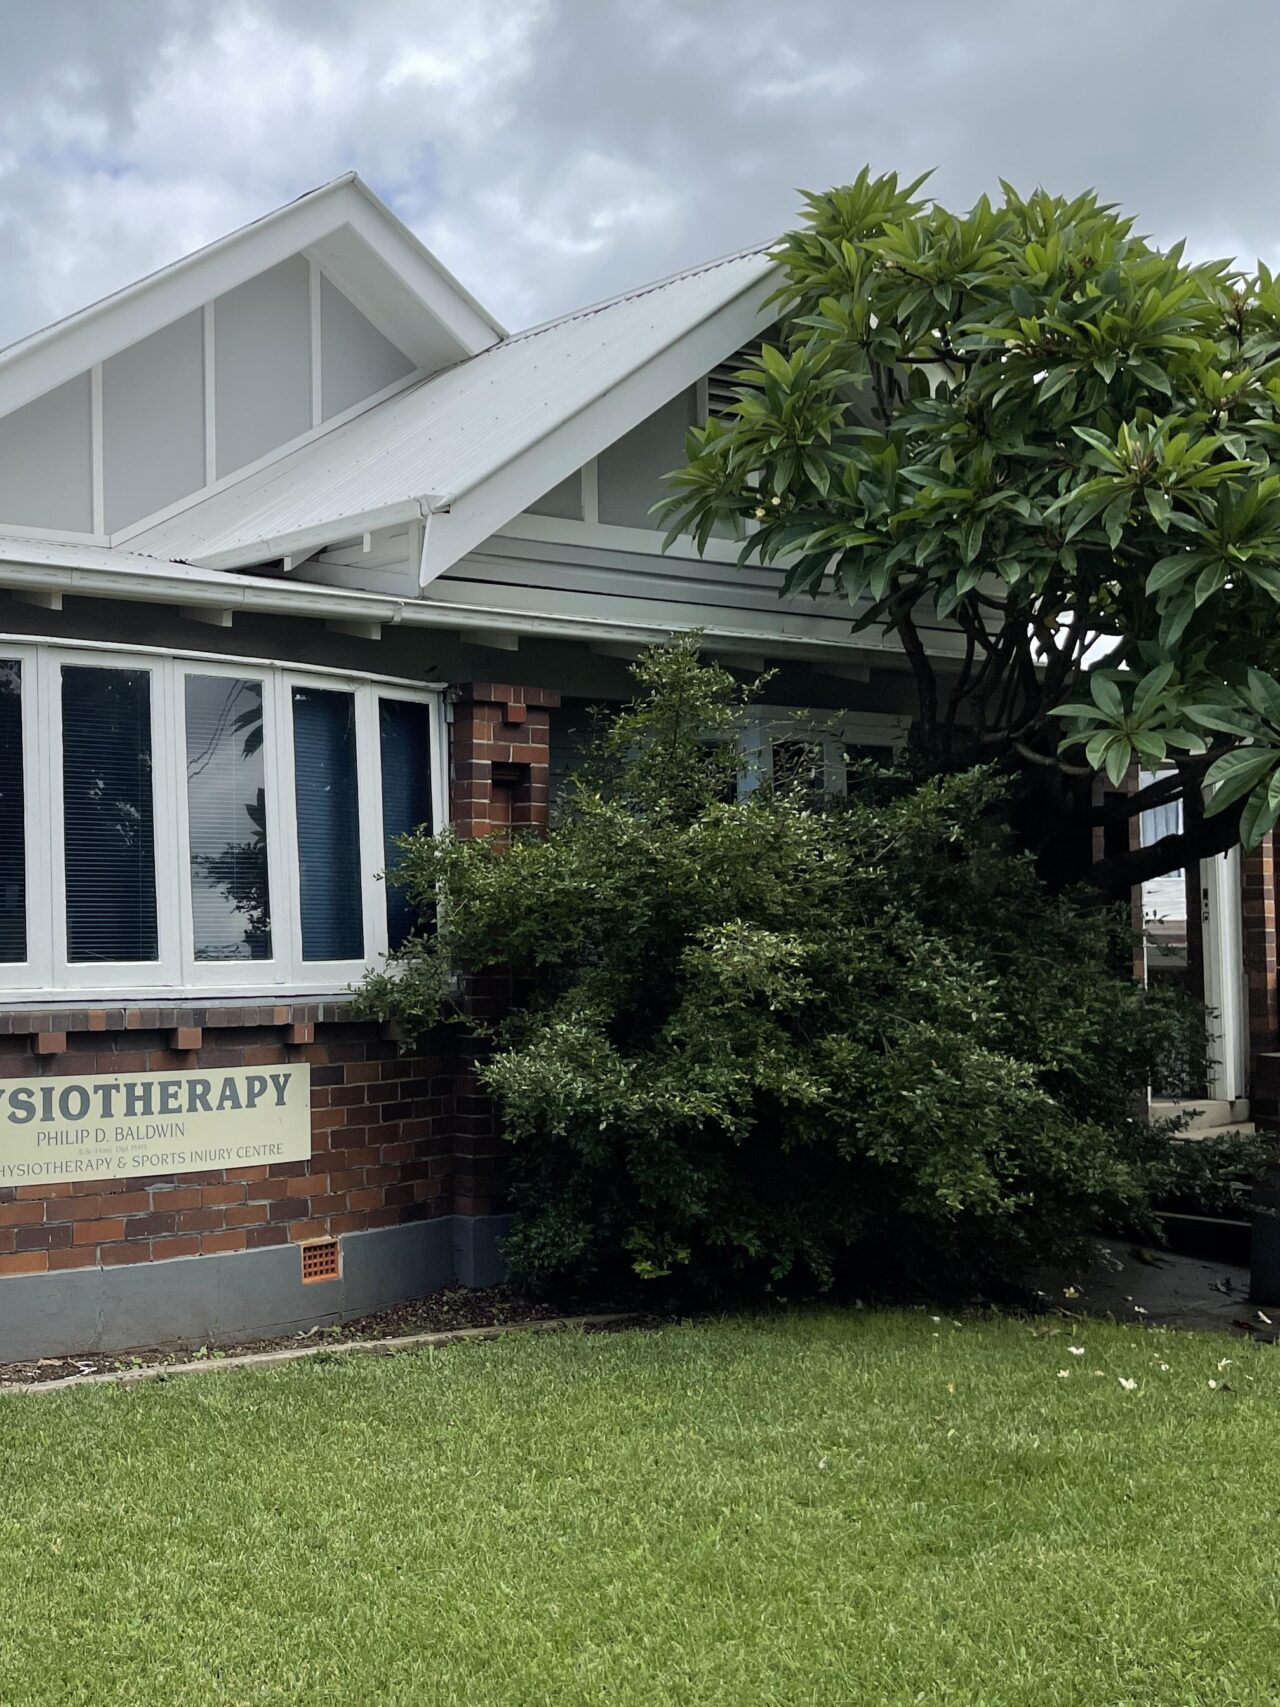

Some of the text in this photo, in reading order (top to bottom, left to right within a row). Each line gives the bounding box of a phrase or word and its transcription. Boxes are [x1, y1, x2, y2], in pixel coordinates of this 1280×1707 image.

[36, 1121, 186, 1147] PHILIP D. BALDWIN
[117, 1156, 128, 1169] &
[132, 1151, 186, 1168] SPORTS
[190, 1146, 234, 1164] INJURY
[236, 1143, 285, 1159] CENTRE
